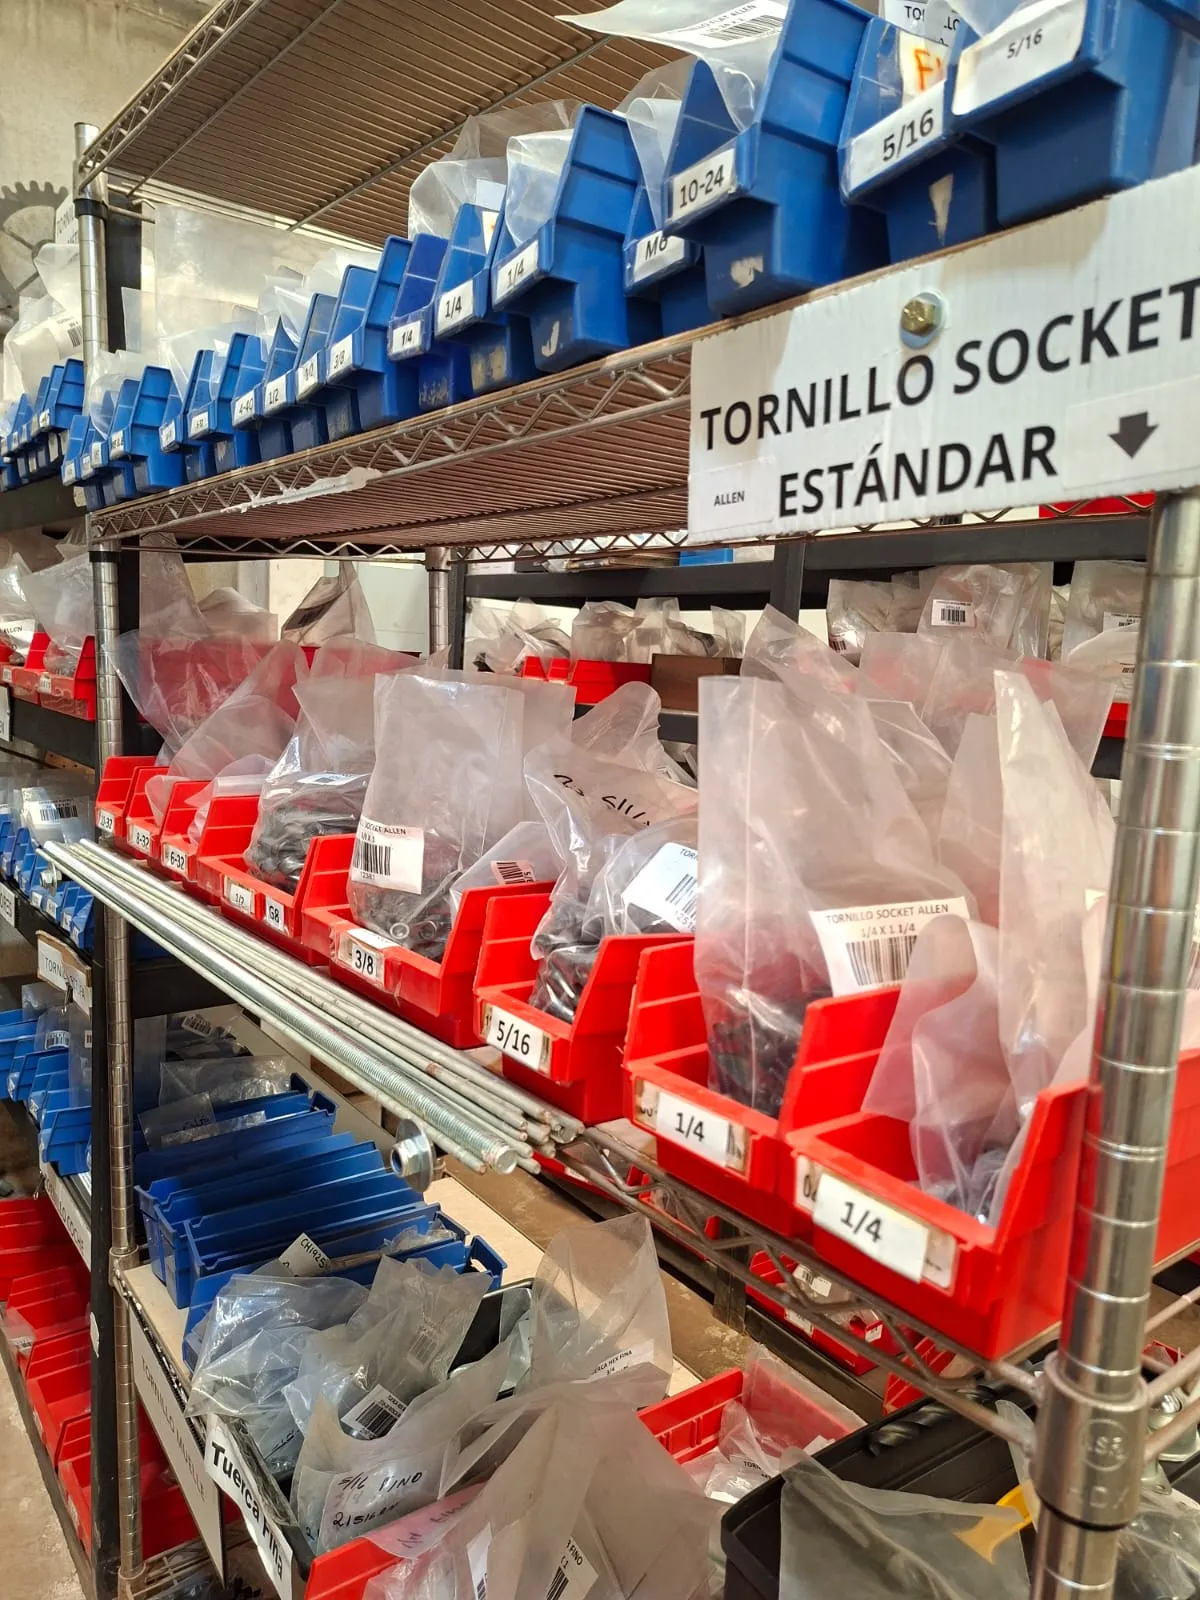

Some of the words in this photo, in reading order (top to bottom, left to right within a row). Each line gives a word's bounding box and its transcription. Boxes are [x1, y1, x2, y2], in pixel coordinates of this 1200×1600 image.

[730, 4, 757, 16] ALLEN
[1006, 28, 1044, 60] 5/16
[882, 108, 935, 162] 5/16
[680, 164, 724, 208] 10-24
[507, 259, 525, 288] 1/4
[445, 295, 462, 318] 1/4
[401, 329, 413, 346] 1/4
[700, 354, 934, 451] TORNILLO
[953, 278, 1200, 395] SOCKET
[779, 424, 1057, 519] ESTÁNDAR
[713, 489, 746, 507] ALLEN
[384, 827, 406, 835] ALLEN
[170, 851, 185, 871] 6-32
[268, 905, 280, 924] G8
[826, 911, 874, 924] TORNILLO
[876, 906, 914, 920] SOCKET
[918, 903, 949, 915] ALLEN
[879, 924, 886, 934] X
[898, 922, 916, 935] 1/4
[354, 950, 375, 975] 3/8
[496, 1020, 531, 1056] 5/16
[675, 1112, 705, 1142] 1/4
[840, 1200, 883, 1243] 1/4
[141, 1354, 175, 1433] TORNILLO
[211, 1440, 260, 1524] Tuerca
[261, 1514, 283, 1581] Fina
